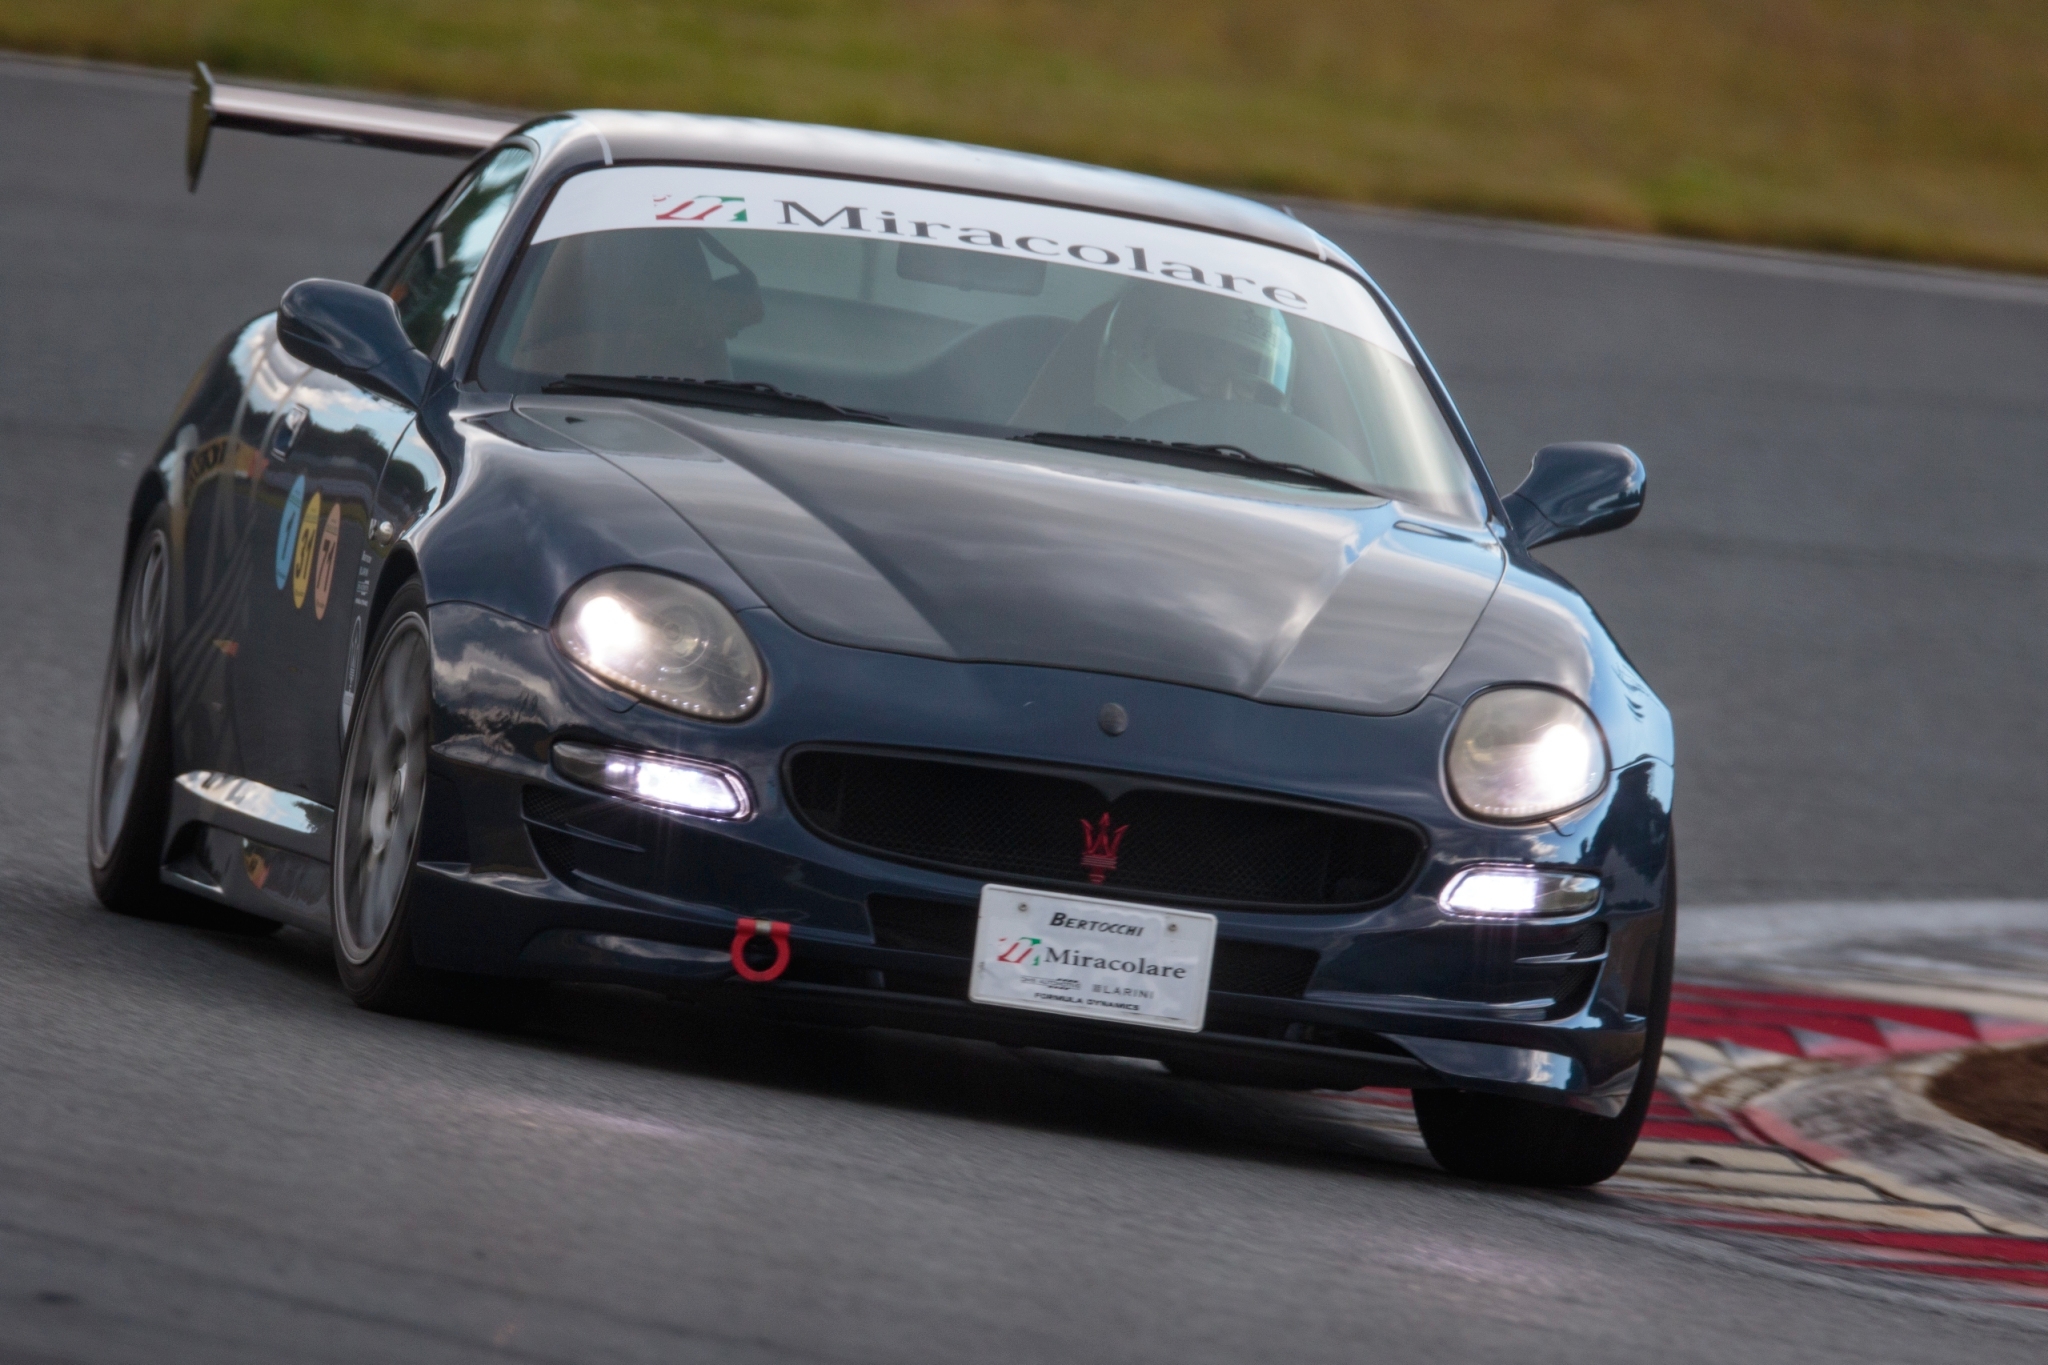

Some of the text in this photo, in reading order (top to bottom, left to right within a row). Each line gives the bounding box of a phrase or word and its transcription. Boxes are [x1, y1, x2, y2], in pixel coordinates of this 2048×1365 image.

[773, 199, 1308, 310] Miracolare
[295, 528, 316, 580] 31
[316, 538, 336, 593] 71
[1049, 912, 1146, 937] BERTOCCHI
[1045, 946, 1187, 980] Miracolare
[1034, 992, 1140, 1011] FORMULA DYNAMICS
